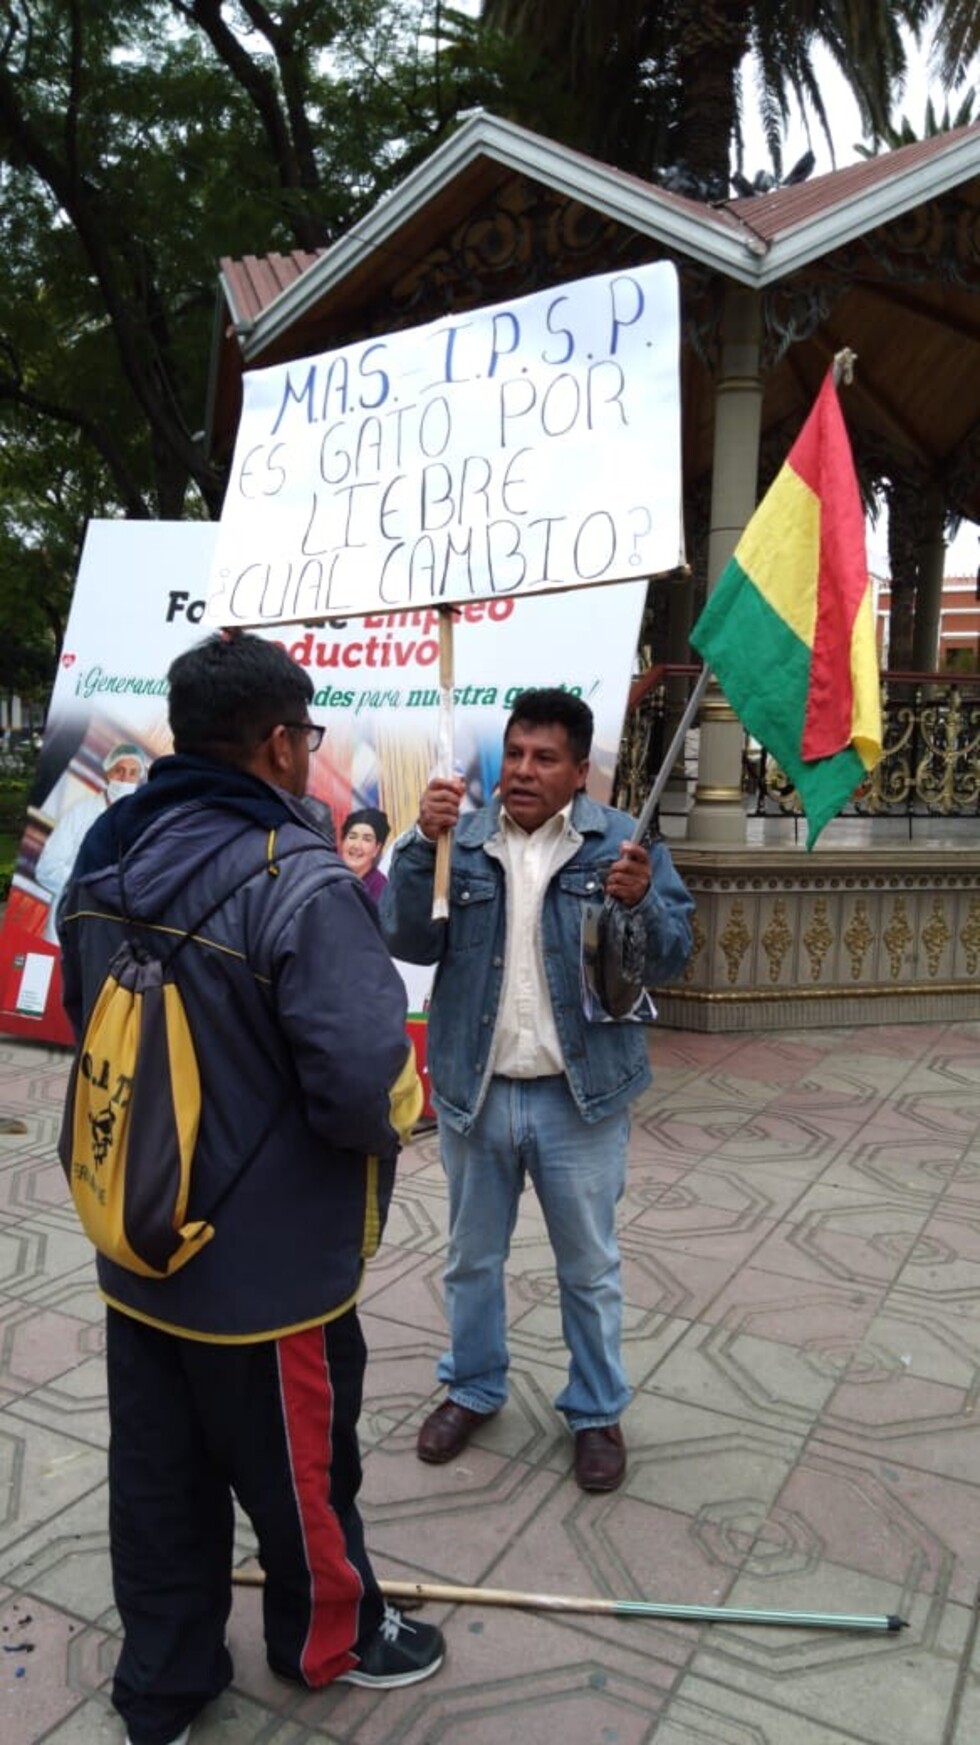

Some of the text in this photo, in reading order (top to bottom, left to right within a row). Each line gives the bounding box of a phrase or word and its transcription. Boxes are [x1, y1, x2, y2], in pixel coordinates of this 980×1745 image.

[238, 360, 630, 500] ES GATO POR
[301, 447, 534, 556] LIEBRE
[378, 505, 653, 605] CAMBIO?
[75, 666, 169, 699] ¡Generand
[355, 690, 401, 716] para
[406, 682, 498, 708] nustra
[272, 632, 441, 668] ductivo
